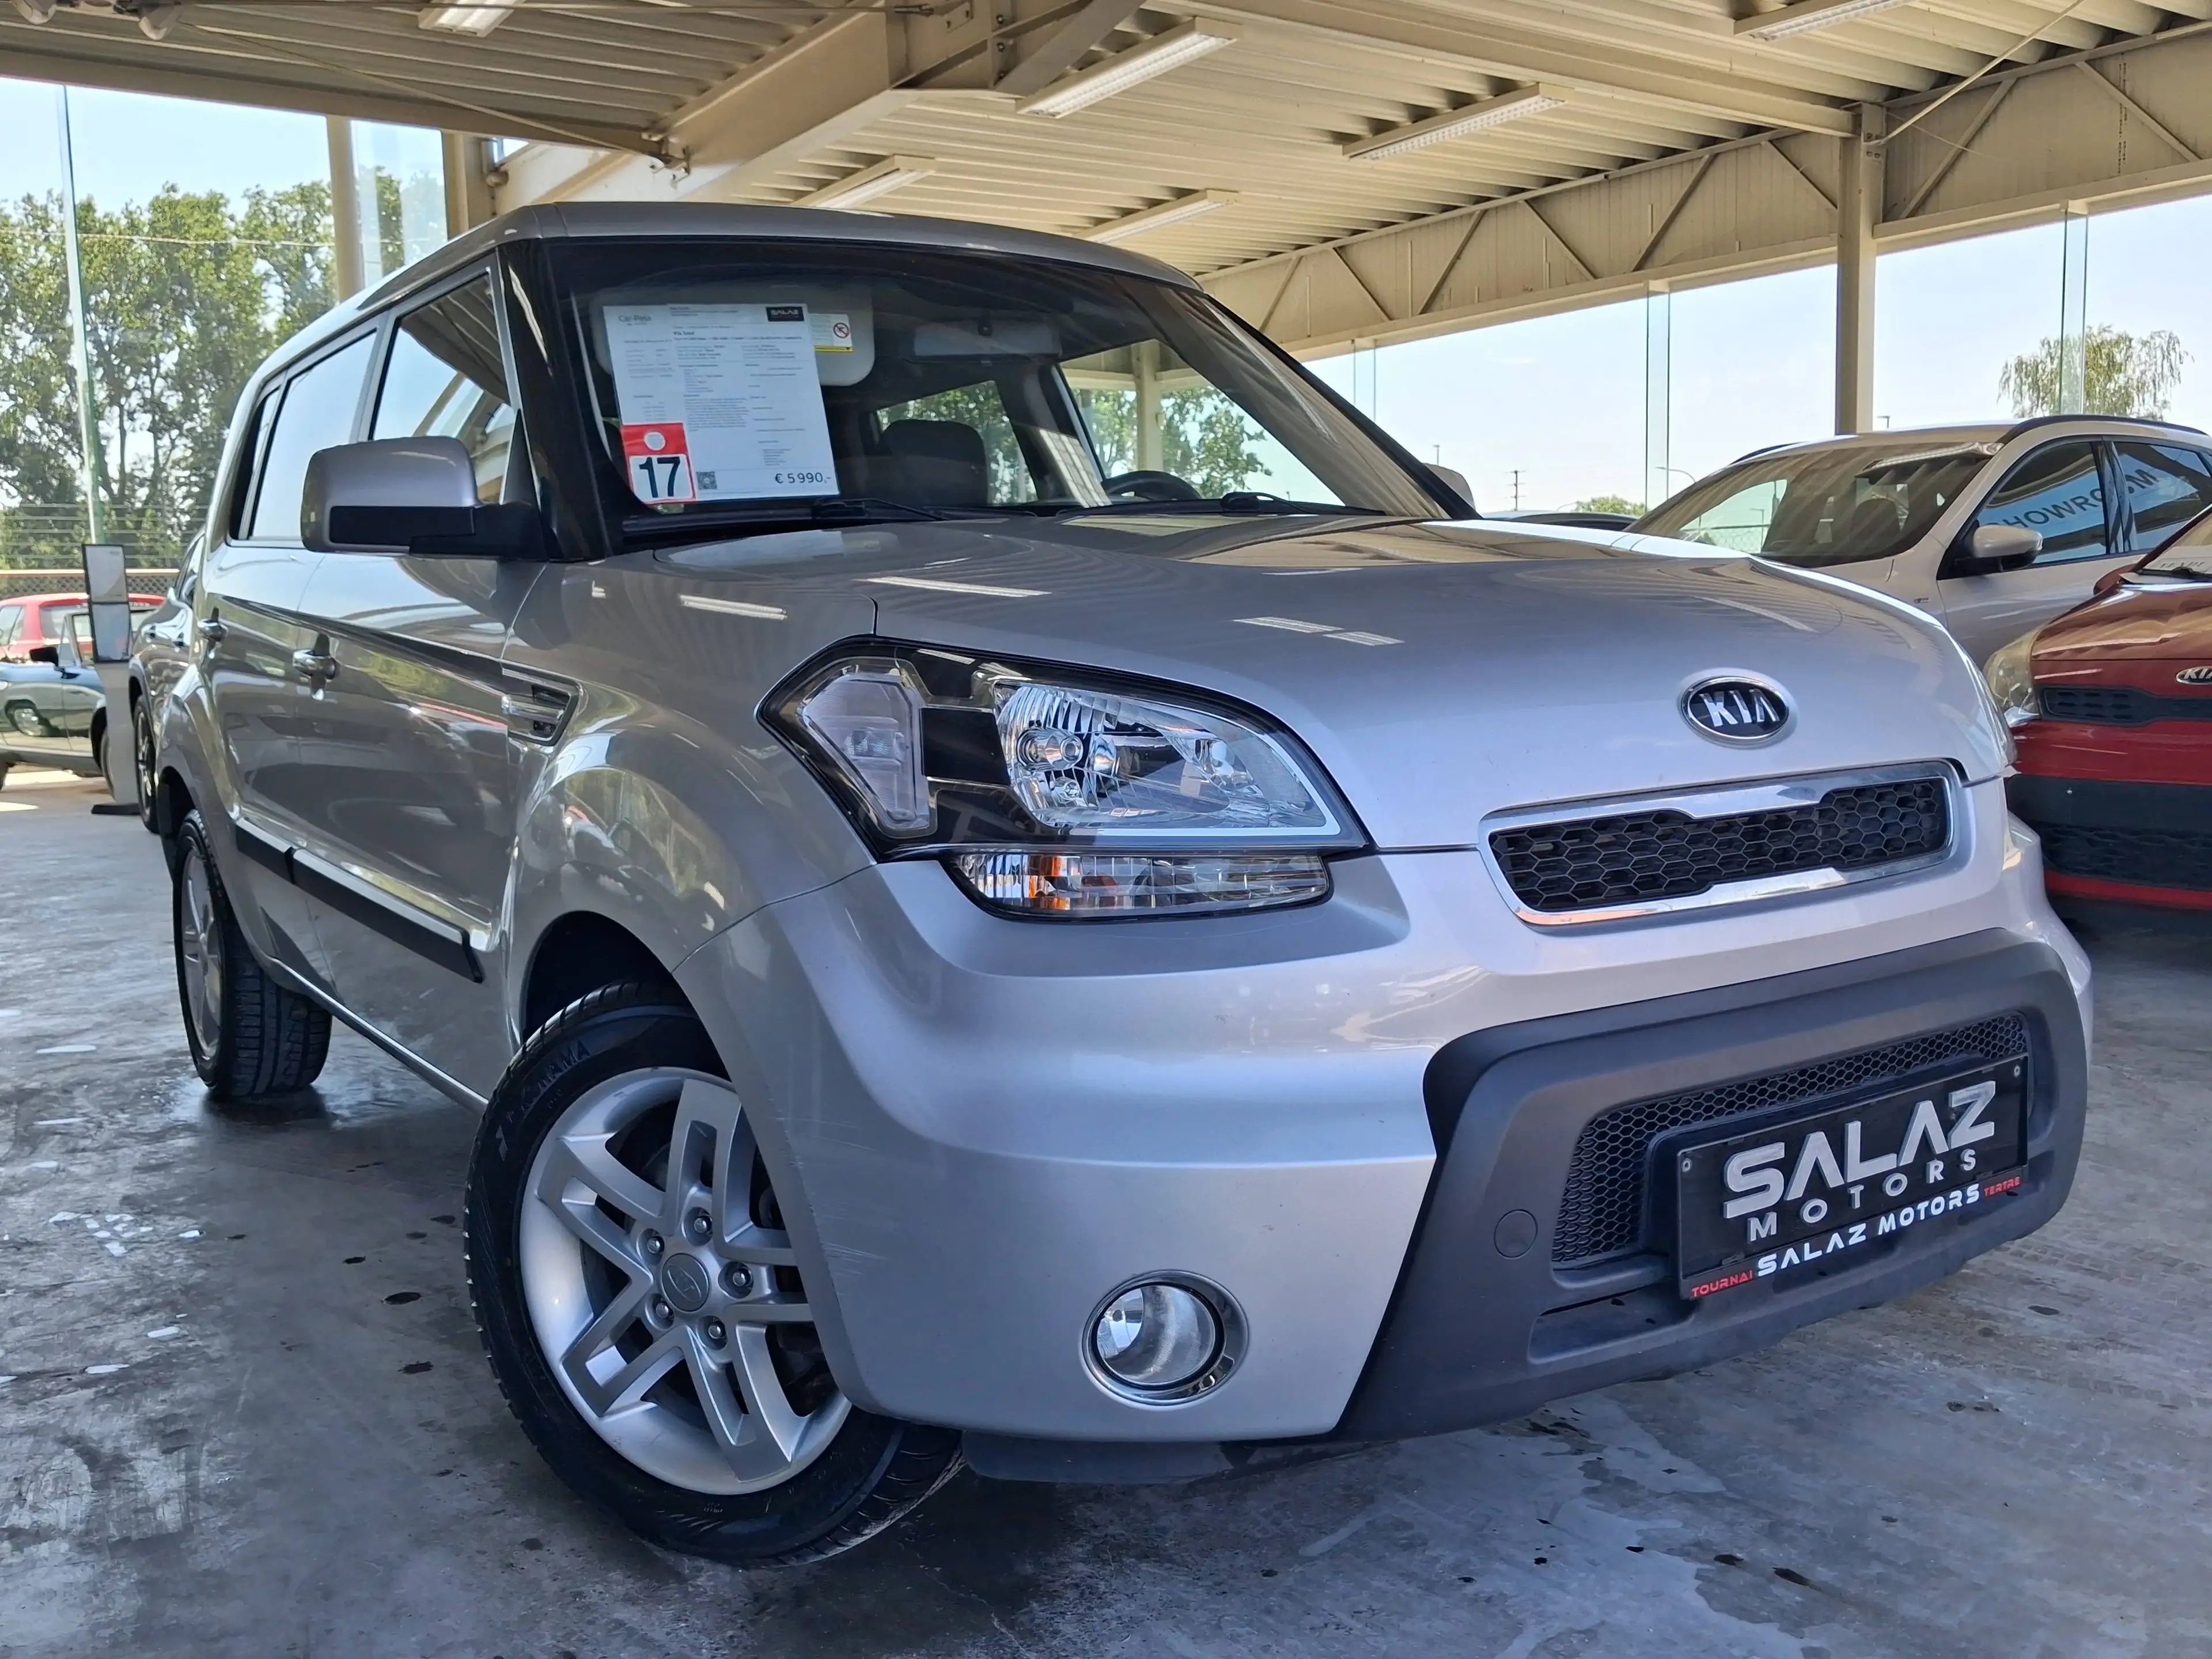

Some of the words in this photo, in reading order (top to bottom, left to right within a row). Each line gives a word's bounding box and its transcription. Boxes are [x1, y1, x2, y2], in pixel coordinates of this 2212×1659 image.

[639, 456, 681, 498] 17
[1698, 688, 1780, 727] KIA
[1723, 1081, 1996, 1219] SALAZ
[1747, 1148, 1976, 1242] MOTORS
[1691, 1269, 1753, 1298] TOURNAI
[1758, 1223, 1866, 1278] SALAZ
[1877, 1183, 1980, 1237] MOTORS
[1983, 1176, 2022, 1198] TERTRE
